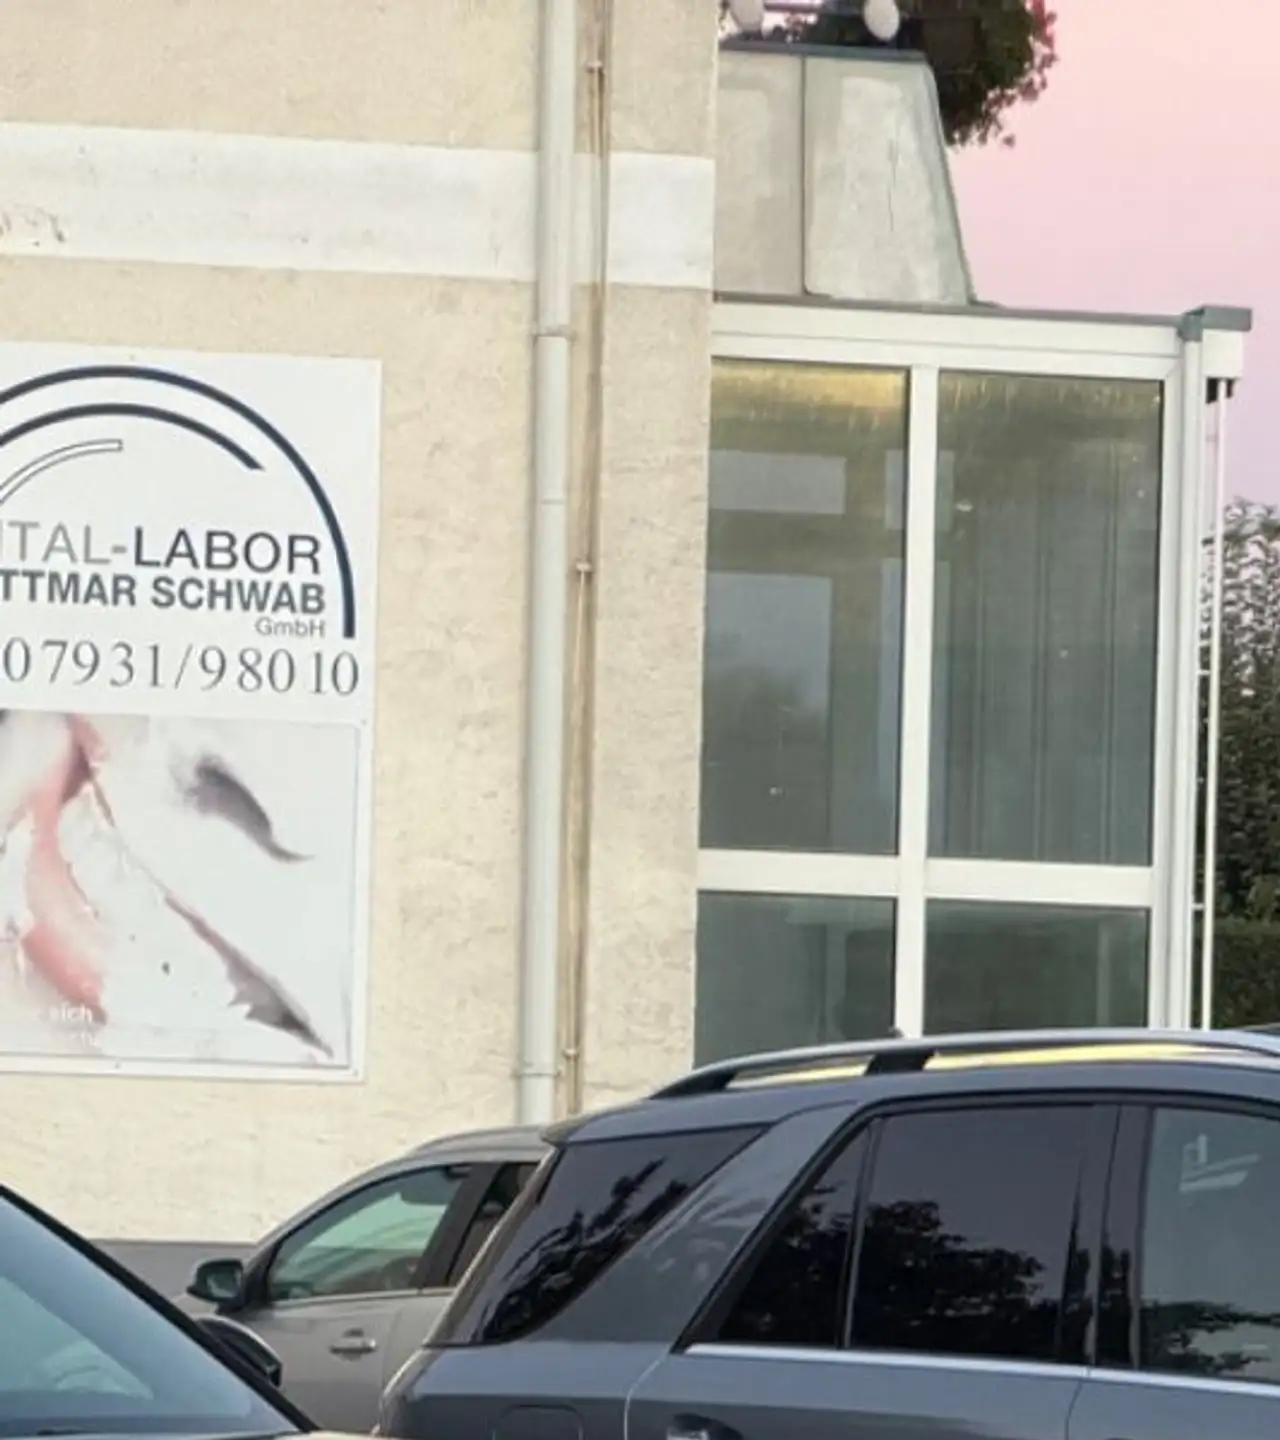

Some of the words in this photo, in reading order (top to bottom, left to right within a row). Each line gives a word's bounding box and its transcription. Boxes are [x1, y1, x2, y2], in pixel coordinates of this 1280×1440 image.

[0, 519, 321, 576] TAL-LABOR
[150, 574, 327, 616] SCHWAB
[254, 616, 326, 639] GmbH
[2, 635, 360, 697] 07931/98010
